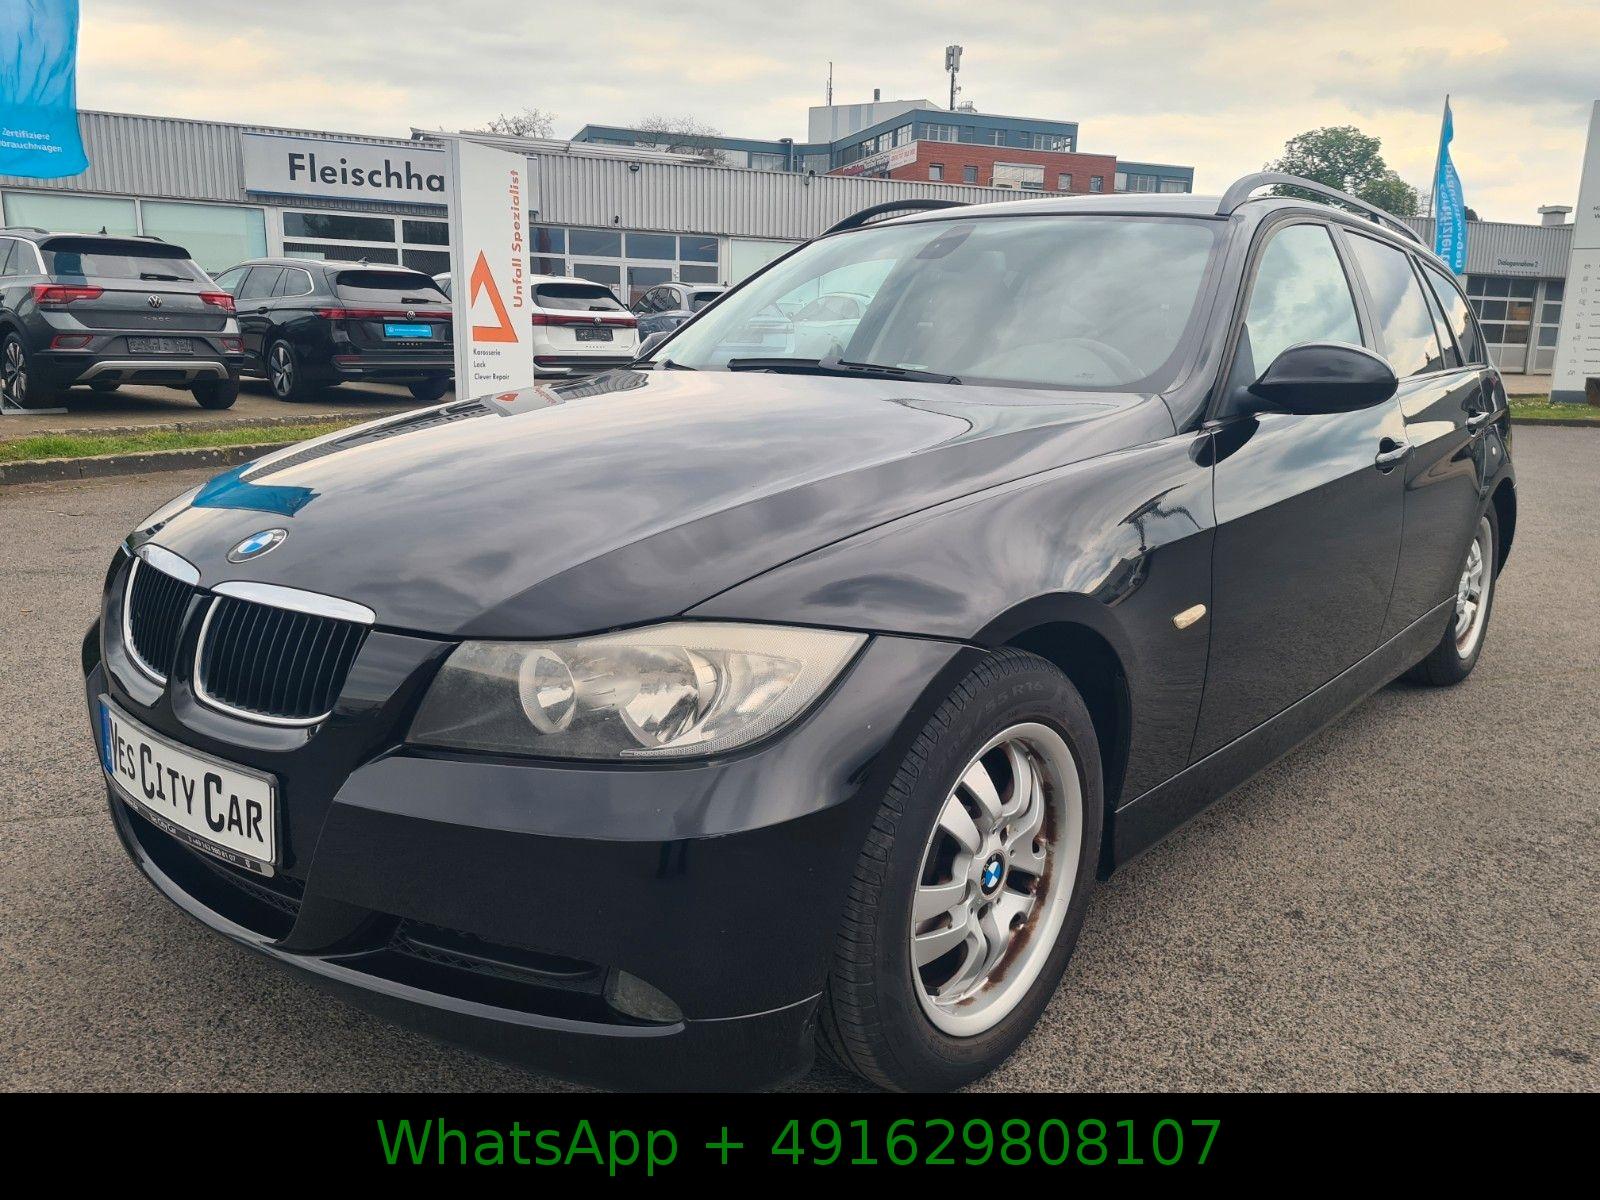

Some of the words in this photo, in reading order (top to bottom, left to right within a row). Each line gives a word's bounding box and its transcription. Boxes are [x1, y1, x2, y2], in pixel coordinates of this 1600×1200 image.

[509, 169, 522, 252] Spezialist
[512, 258, 523, 308] Unfall
[140, 743, 195, 815] CITY
[204, 772, 264, 842] CAR
